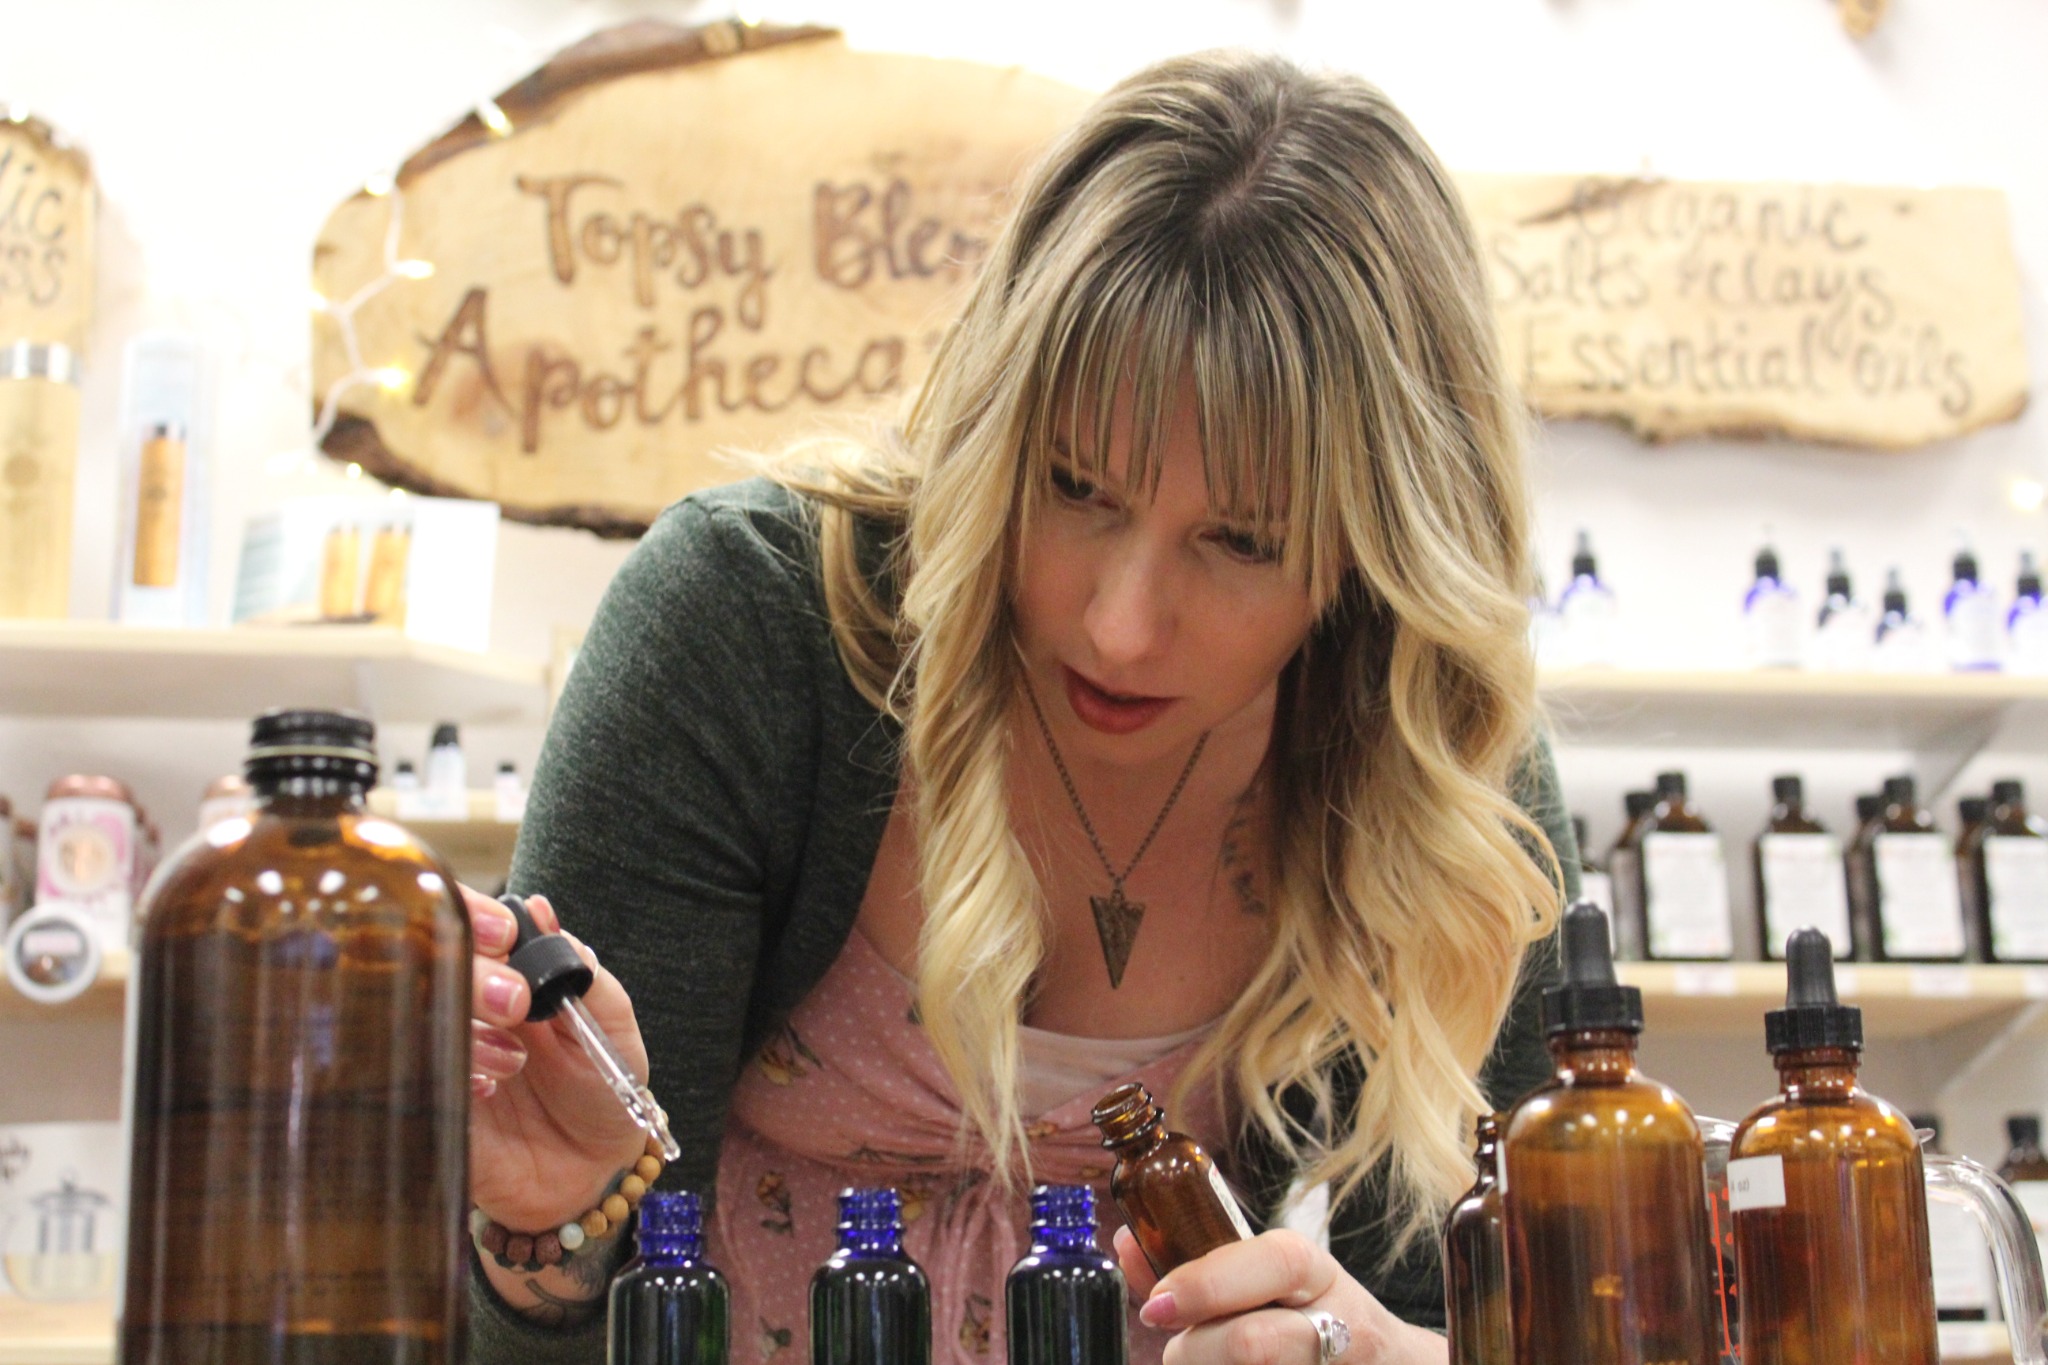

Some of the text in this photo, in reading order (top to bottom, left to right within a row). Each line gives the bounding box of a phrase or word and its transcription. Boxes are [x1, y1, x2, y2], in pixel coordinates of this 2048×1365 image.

[515, 173, 777, 331] Topsy
[1490, 232, 1650, 311] Salts
[1521, 313, 1830, 396] Essential
